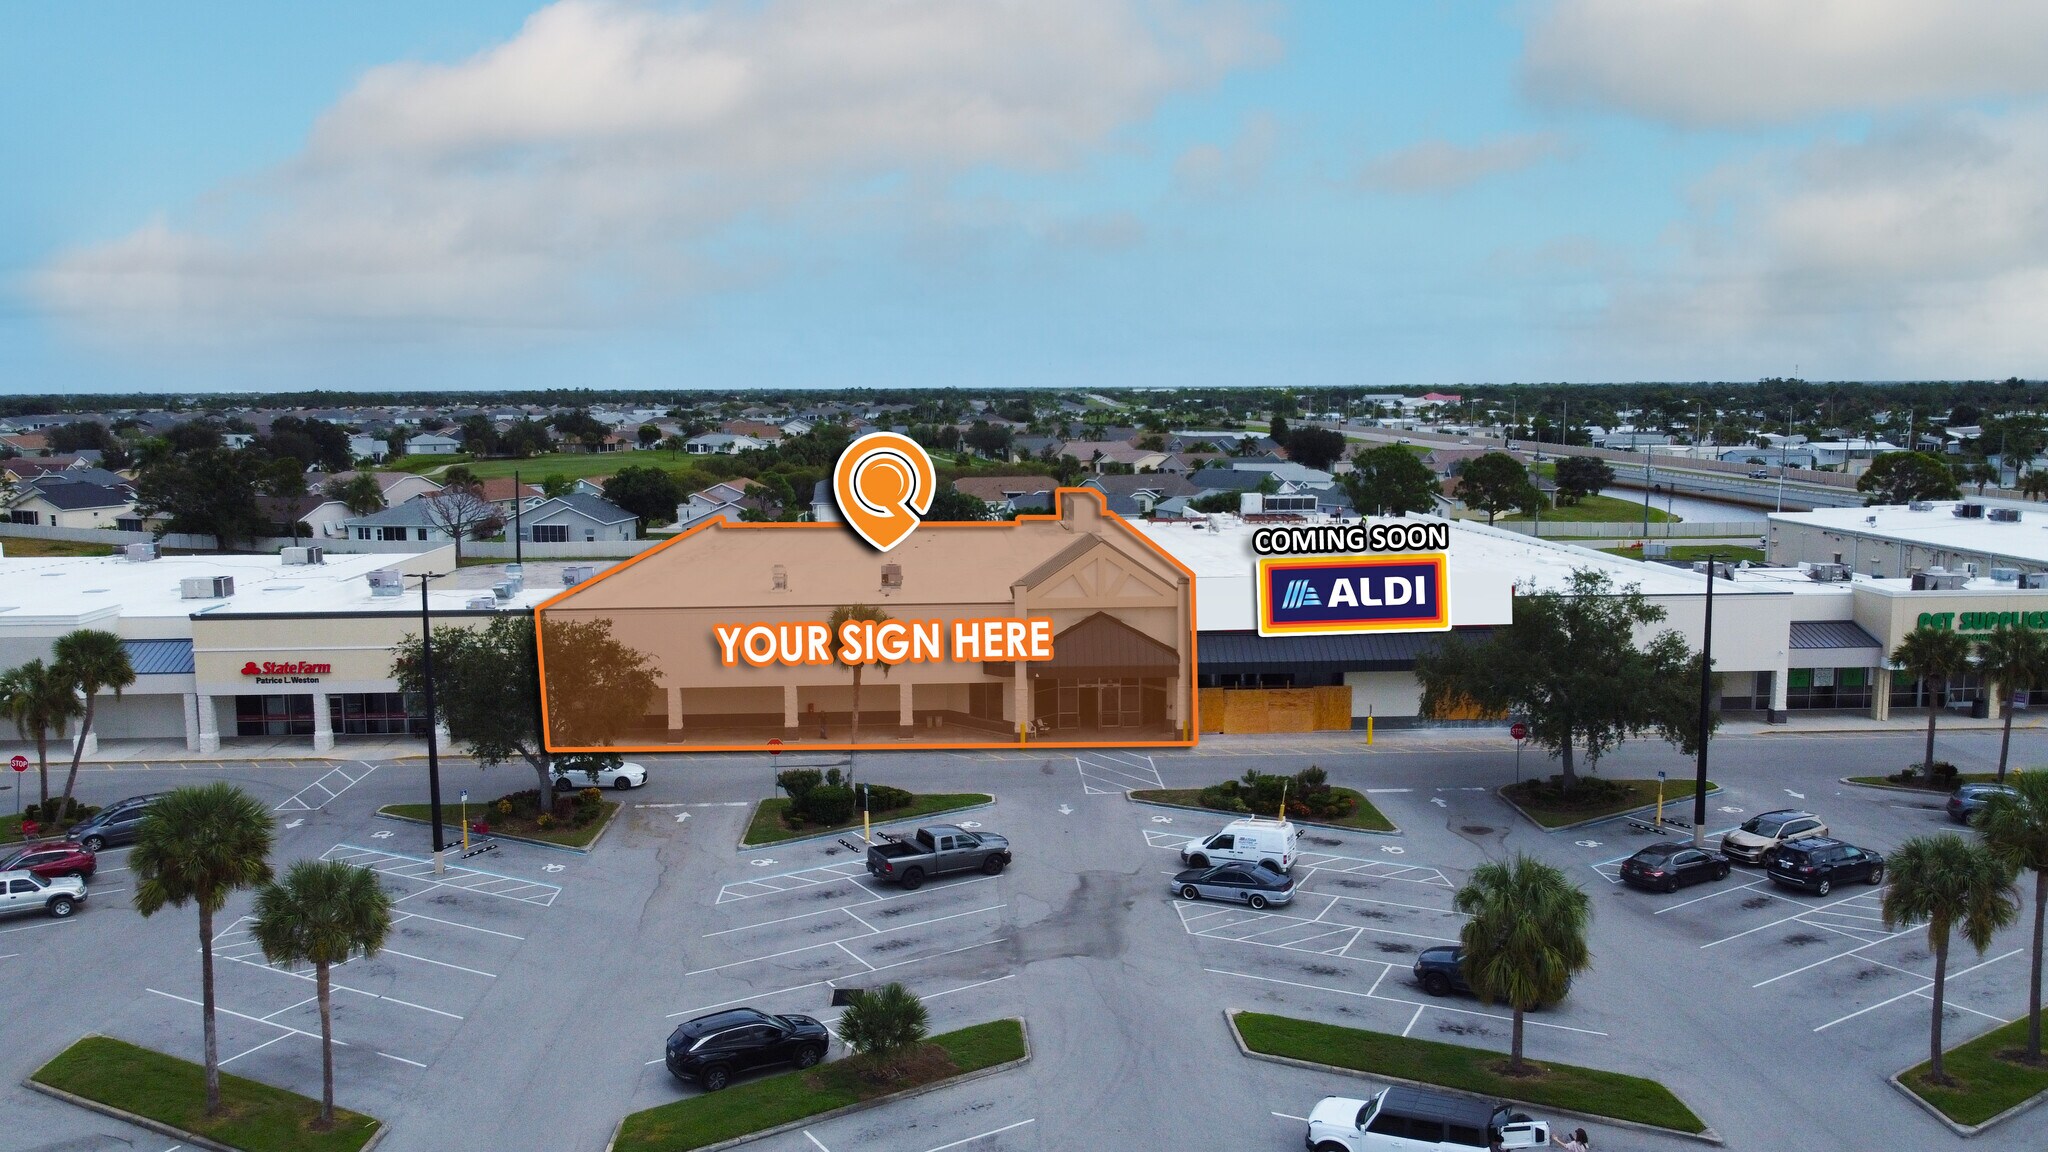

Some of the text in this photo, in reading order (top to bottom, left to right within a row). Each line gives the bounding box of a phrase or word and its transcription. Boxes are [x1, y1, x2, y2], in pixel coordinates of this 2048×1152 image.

[1917, 612, 1955, 630] PET
[291, 676, 319, 684] Weston
[11, 759, 28, 767] STOP
